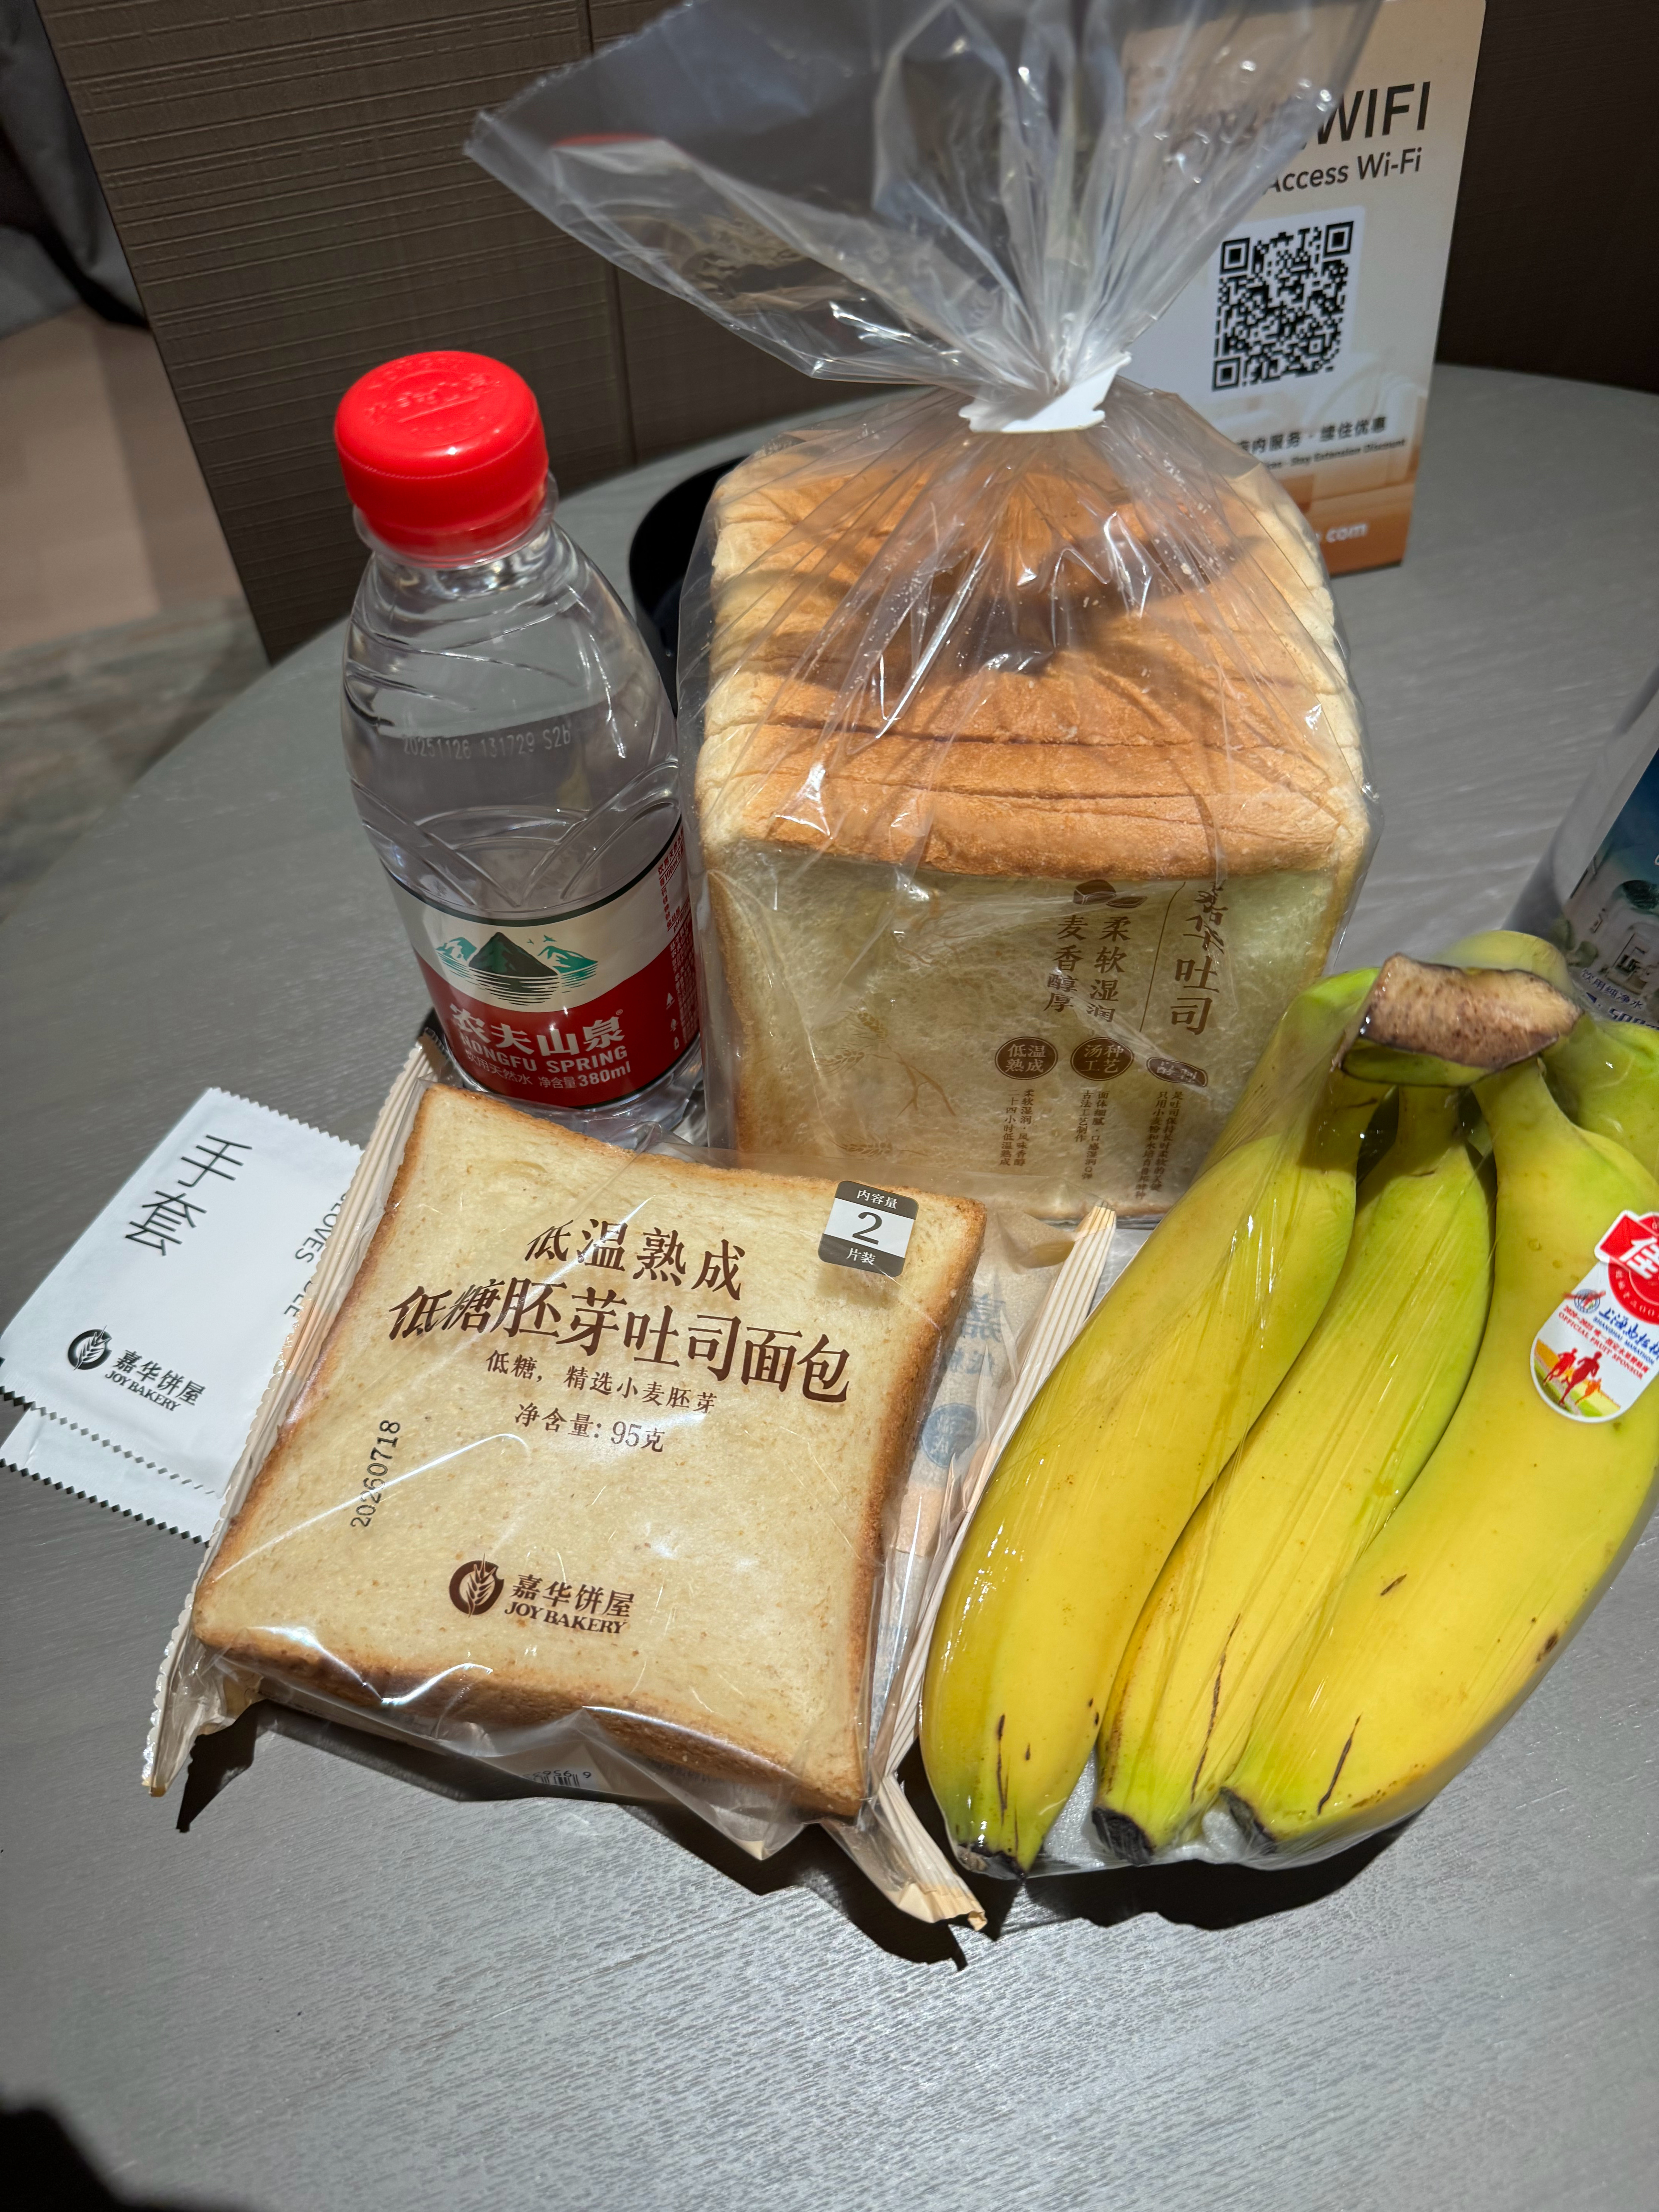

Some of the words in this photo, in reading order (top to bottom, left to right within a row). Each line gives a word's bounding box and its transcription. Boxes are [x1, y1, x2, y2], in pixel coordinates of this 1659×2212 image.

[1357, 147, 1422, 180] Wi-Fi
[481, 732, 535, 758] 131729
[1044, 914, 1087, 1012] 麦香醇厚
[1087, 915, 1132, 1022] 柔软湿润
[450, 1005, 625, 1056] 农夫山泉
[1007, 1044, 1046, 1058] 低温
[1084, 1044, 1125, 1058] 汤种
[461, 1033, 537, 1072] NONGFU
[546, 1044, 628, 1073] SPRING
[465, 1051, 533, 1085] 饮用天然水
[1005, 1059, 1044, 1073] 熟成
[1080, 1060, 1120, 1073] 工艺
[1075, 1090, 1094, 1143] 古法工艺制作
[125, 1134, 252, 1256] 手套
[856, 1188, 898, 1209] 内容量
[295, 1193, 346, 1263] LOVES
[852, 1212, 882, 1245] 2
[524, 1218, 745, 1301] 低温熟成
[846, 1248, 876, 1266] 片装
[388, 1277, 851, 1403] 低糖胚芽吐司面包
[1558, 1312, 1589, 1340] OFFICIAL
[1590, 1336, 1612, 1355] FRUIT
[1612, 1353, 1643, 1380] SPONSOR
[1625, 1340, 1654, 1365] MARATHON
[105, 1370, 134, 1391] JOY
[129, 1381, 181, 1412] BAKERY
[112, 1349, 206, 1407] 嘉华饼屋
[350, 1419, 401, 1528] 20260718
[510, 1574, 635, 1617] 嘉华饼屋
[504, 1602, 544, 1619] JOY
[543, 1609, 627, 1634] BAKERY
